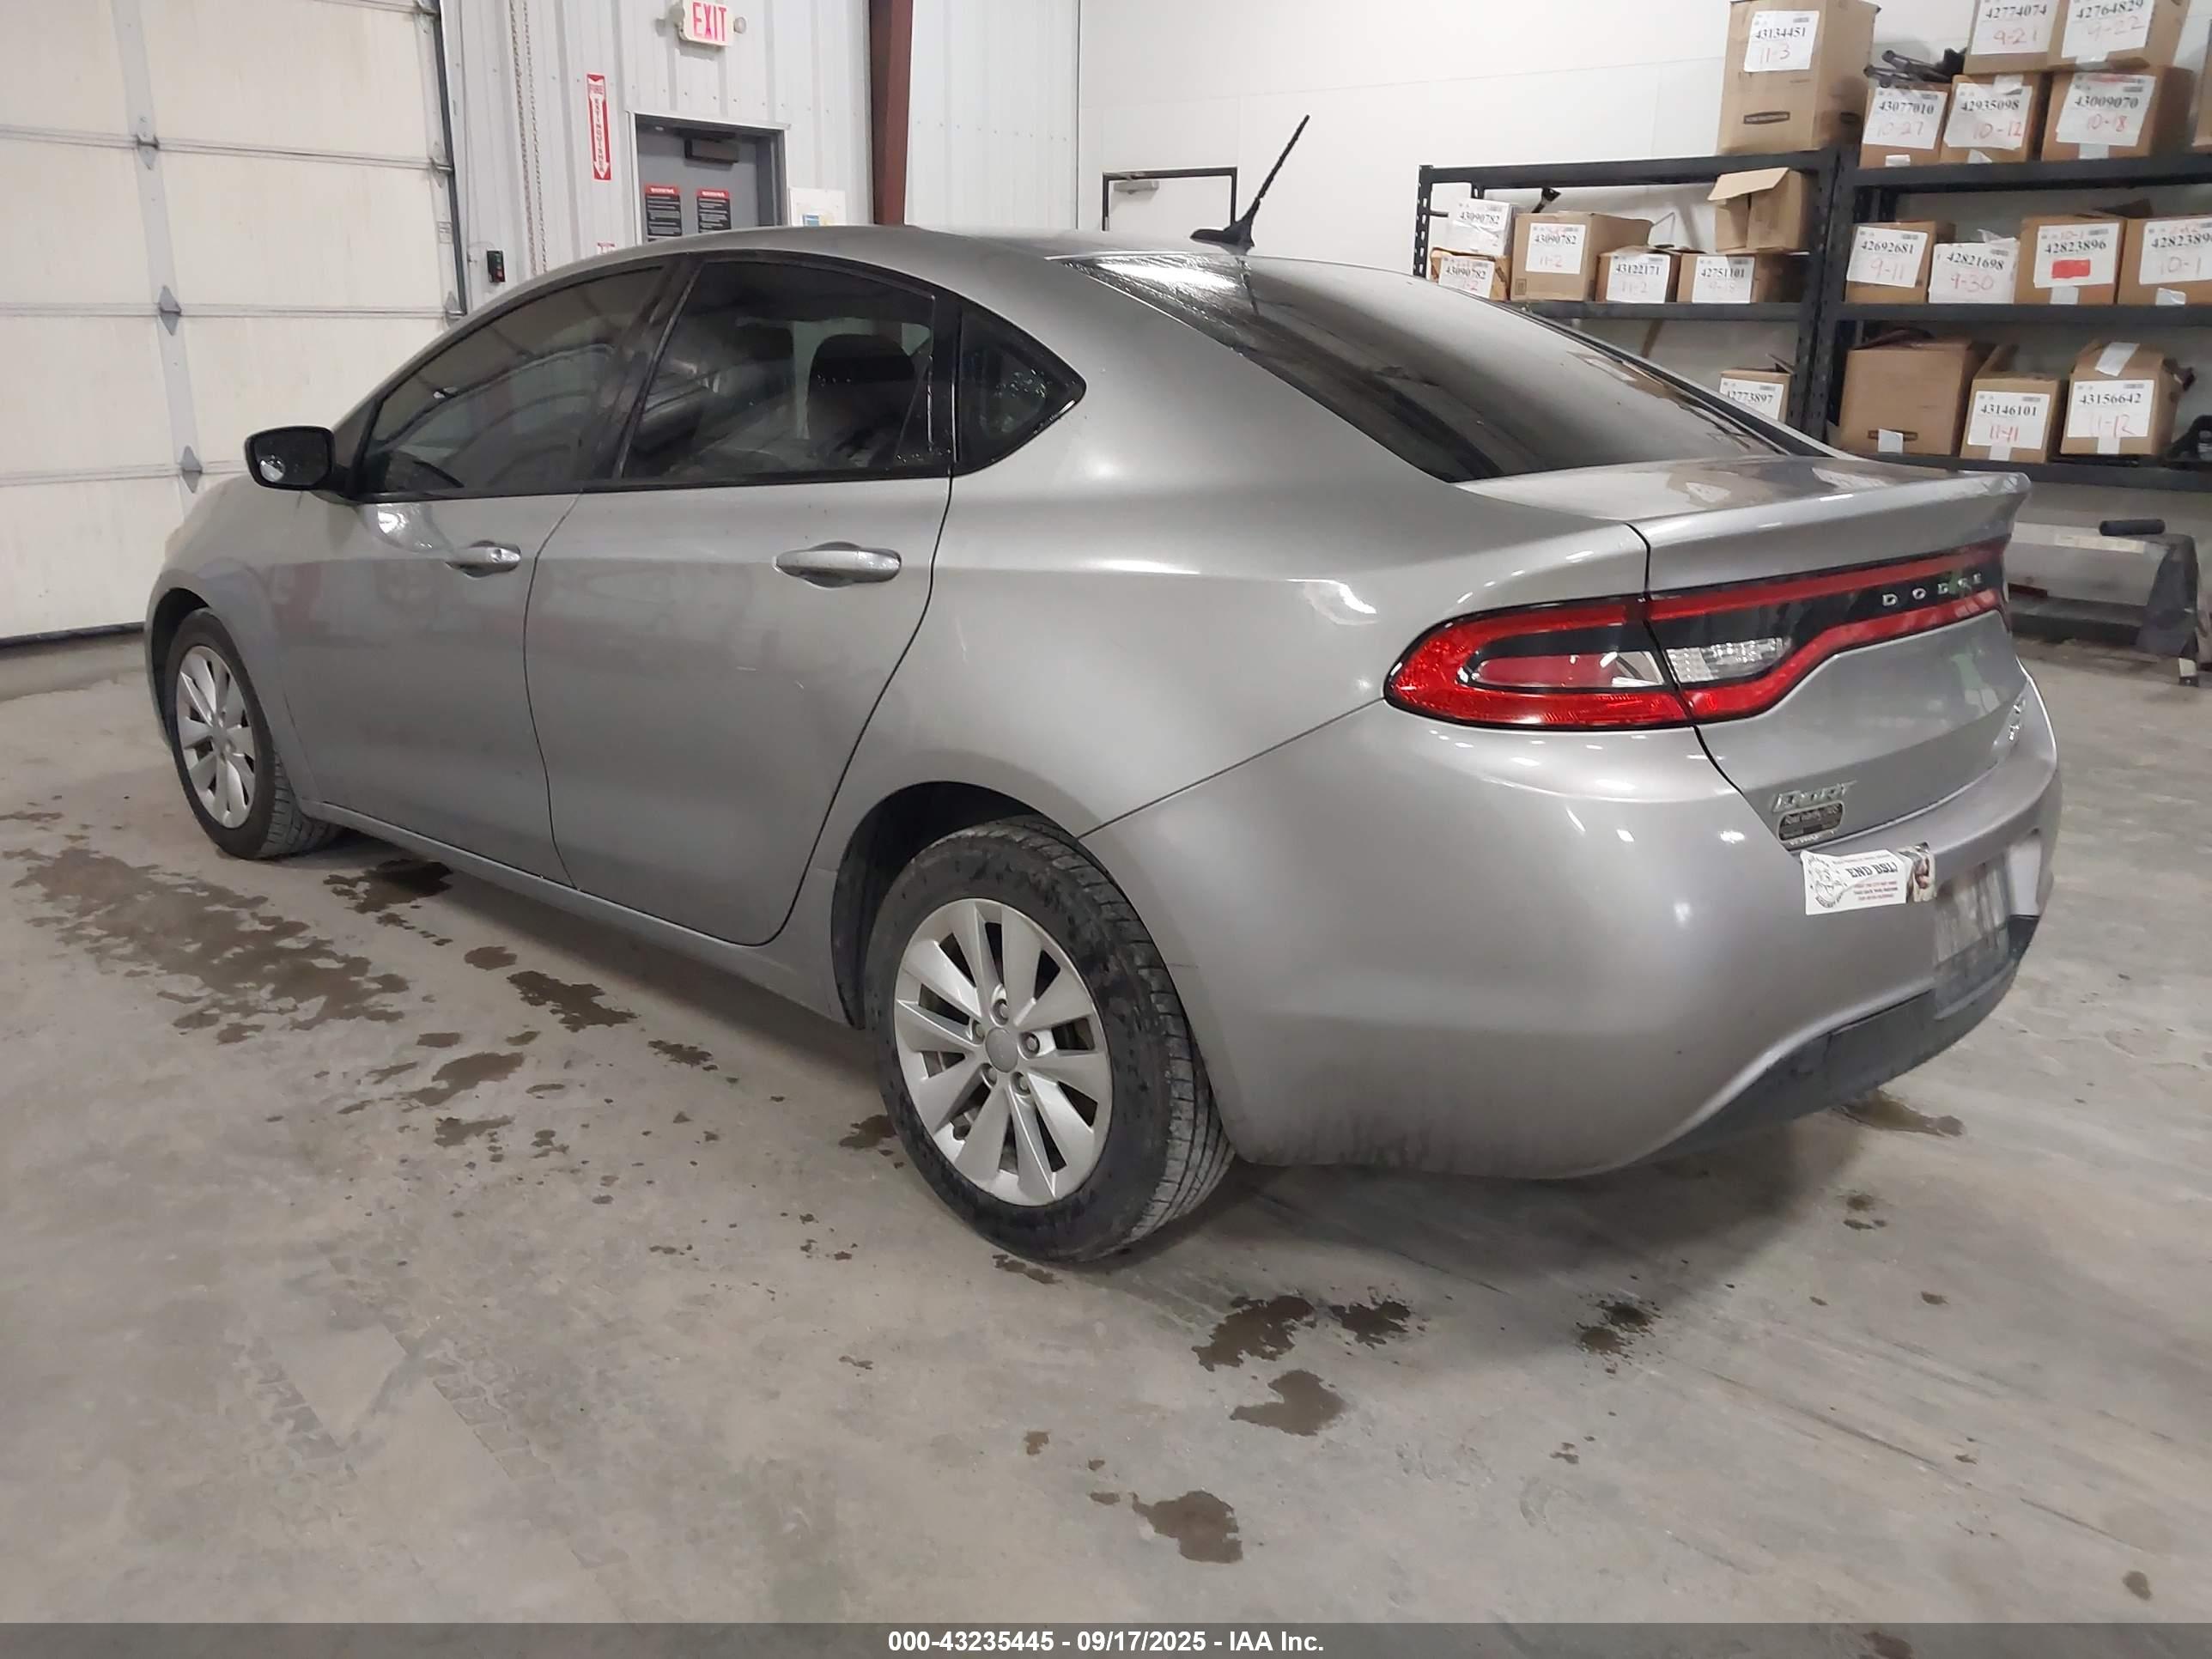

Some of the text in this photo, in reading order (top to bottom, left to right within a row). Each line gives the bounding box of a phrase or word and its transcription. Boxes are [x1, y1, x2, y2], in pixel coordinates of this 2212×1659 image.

[1984, 3, 2048, 19] 42774074
[2075, 0, 2144, 19] 42764829
[692, 2, 727, 41] EXIT
[1754, 27, 1807, 40] 43134451
[1992, 27, 2038, 45] 9-21
[1878, 100, 1936, 115] 43077010
[1960, 99, 2021, 112] 42935098
[2074, 94, 2139, 109] 43009070
[1533, 233, 1577, 246] 43090782
[2044, 238, 2107, 255] 42823896
[1860, 240, 1914, 255] 42692681
[1946, 251, 2006, 271] 42821698
[1614, 264, 1661, 276] 43122171
[1699, 267, 1746, 279] 42751101
[2079, 392, 2142, 407] 43156642
[1980, 404, 2038, 417] 43146101
[1846, 865, 1874, 878] END
